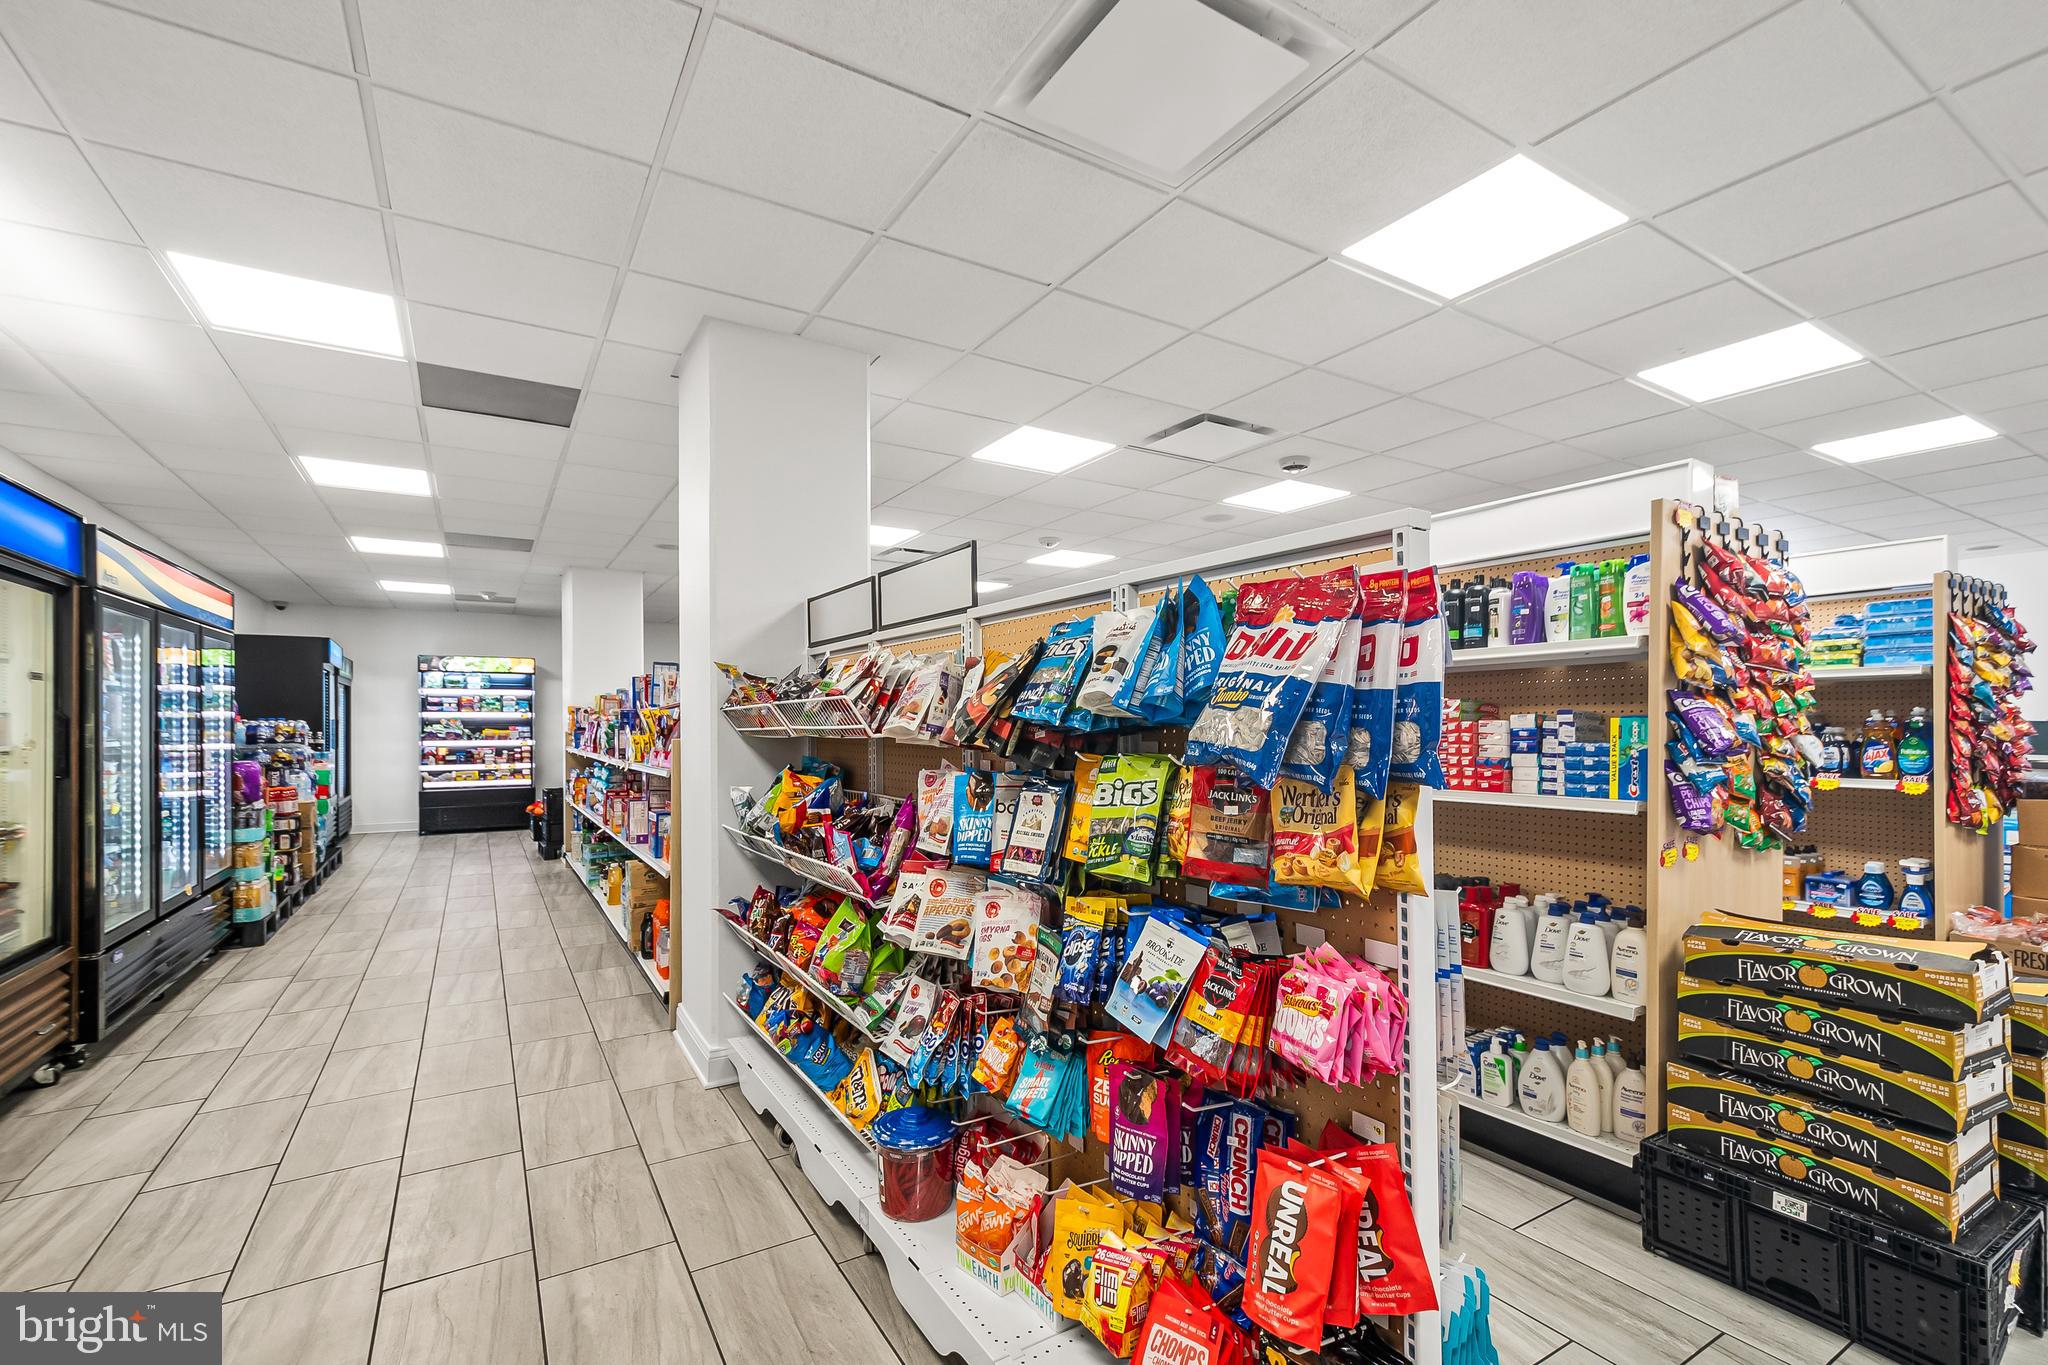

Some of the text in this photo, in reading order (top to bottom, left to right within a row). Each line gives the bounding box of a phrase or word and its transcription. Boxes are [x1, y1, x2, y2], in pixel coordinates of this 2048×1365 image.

[1379, 577, 1400, 588] PROTEIN
[1410, 575, 1431, 587] PROTEIN
[1211, 687, 1249, 706] Jumbo
[1865, 749, 1888, 761] AJAX
[1629, 759, 1640, 797] Crest
[1208, 790, 1230, 801] JACK
[959, 817, 993, 831] SKINNY
[1292, 805, 1338, 830] Original
[957, 828, 992, 843] DIPPED
[922, 904, 976, 918] APRICOTS
[1856, 907, 1881, 915] SALE
[1892, 910, 1919, 918] SALE
[1544, 927, 1562, 935] Dove
[1573, 934, 1591, 943] Dove
[1064, 938, 1095, 957] clipse
[1616, 946, 1639, 955] Aveeno
[1734, 930, 1804, 945] FLAVOR
[1836, 943, 1918, 963] GROWN
[2014, 952, 2048, 971] FRES
[1738, 959, 1902, 1005] FLAVOR GROWN
[1924, 973, 1954, 983] POIRES
[1938, 980, 1969, 989] POMME
[1203, 978, 1219, 994] JACK
[1814, 989, 1848, 998] DIFFERENCE
[1728, 998, 1881, 1056] FLAVOR GROWN
[1904, 1027, 1934, 1038] POIRES
[1917, 1035, 1946, 1046] POMME
[1529, 1071, 1547, 1081] Dove
[1732, 1041, 1884, 1104] FLAVOR GROWN
[1019, 1076, 1051, 1088] SMART
[1093, 1077, 1109, 1094] ZE
[1568, 1082, 1587, 1093] Aveeno
[1907, 1077, 1938, 1089] POIRES
[1012, 1088, 1049, 1100] SWEETS
[1621, 1086, 1646, 1097] Aveeno
[1920, 1086, 1950, 1097] POMME
[1719, 1093, 1877, 1163] FLAVOR GROWN
[1113, 1127, 1156, 1156] SKINNY
[1207, 1118, 1220, 1156] CRUNCH
[1901, 1135, 1931, 1149] POIRES
[1914, 1145, 1944, 1158] POMME
[2015, 1152, 2044, 1163] POMME
[1113, 1147, 1154, 1176] DIPPED
[1230, 1117, 1249, 1214] CRUNCH
[1120, 1169, 1147, 1182] CHOCOLATE
[1721, 1136, 1878, 1211] FLAVOR GROWN
[1137, 1180, 1150, 1189] CUPS
[1901, 1184, 1944, 1202] POIRES DE
[1914, 1194, 1944, 1207] POMME
[1262, 1180, 1308, 1295] UNREAL
[1094, 1248, 1107, 1260] 26
[1106, 1251, 1132, 1263] ORIGINAL
[1094, 1265, 1118, 1290] slim
[1372, 1284, 1401, 1292] chocolate
[1375, 1291, 1411, 1300] butter cups
[1283, 1313, 1300, 1327] cups
[1150, 1328, 1206, 1365] CHOMPS
